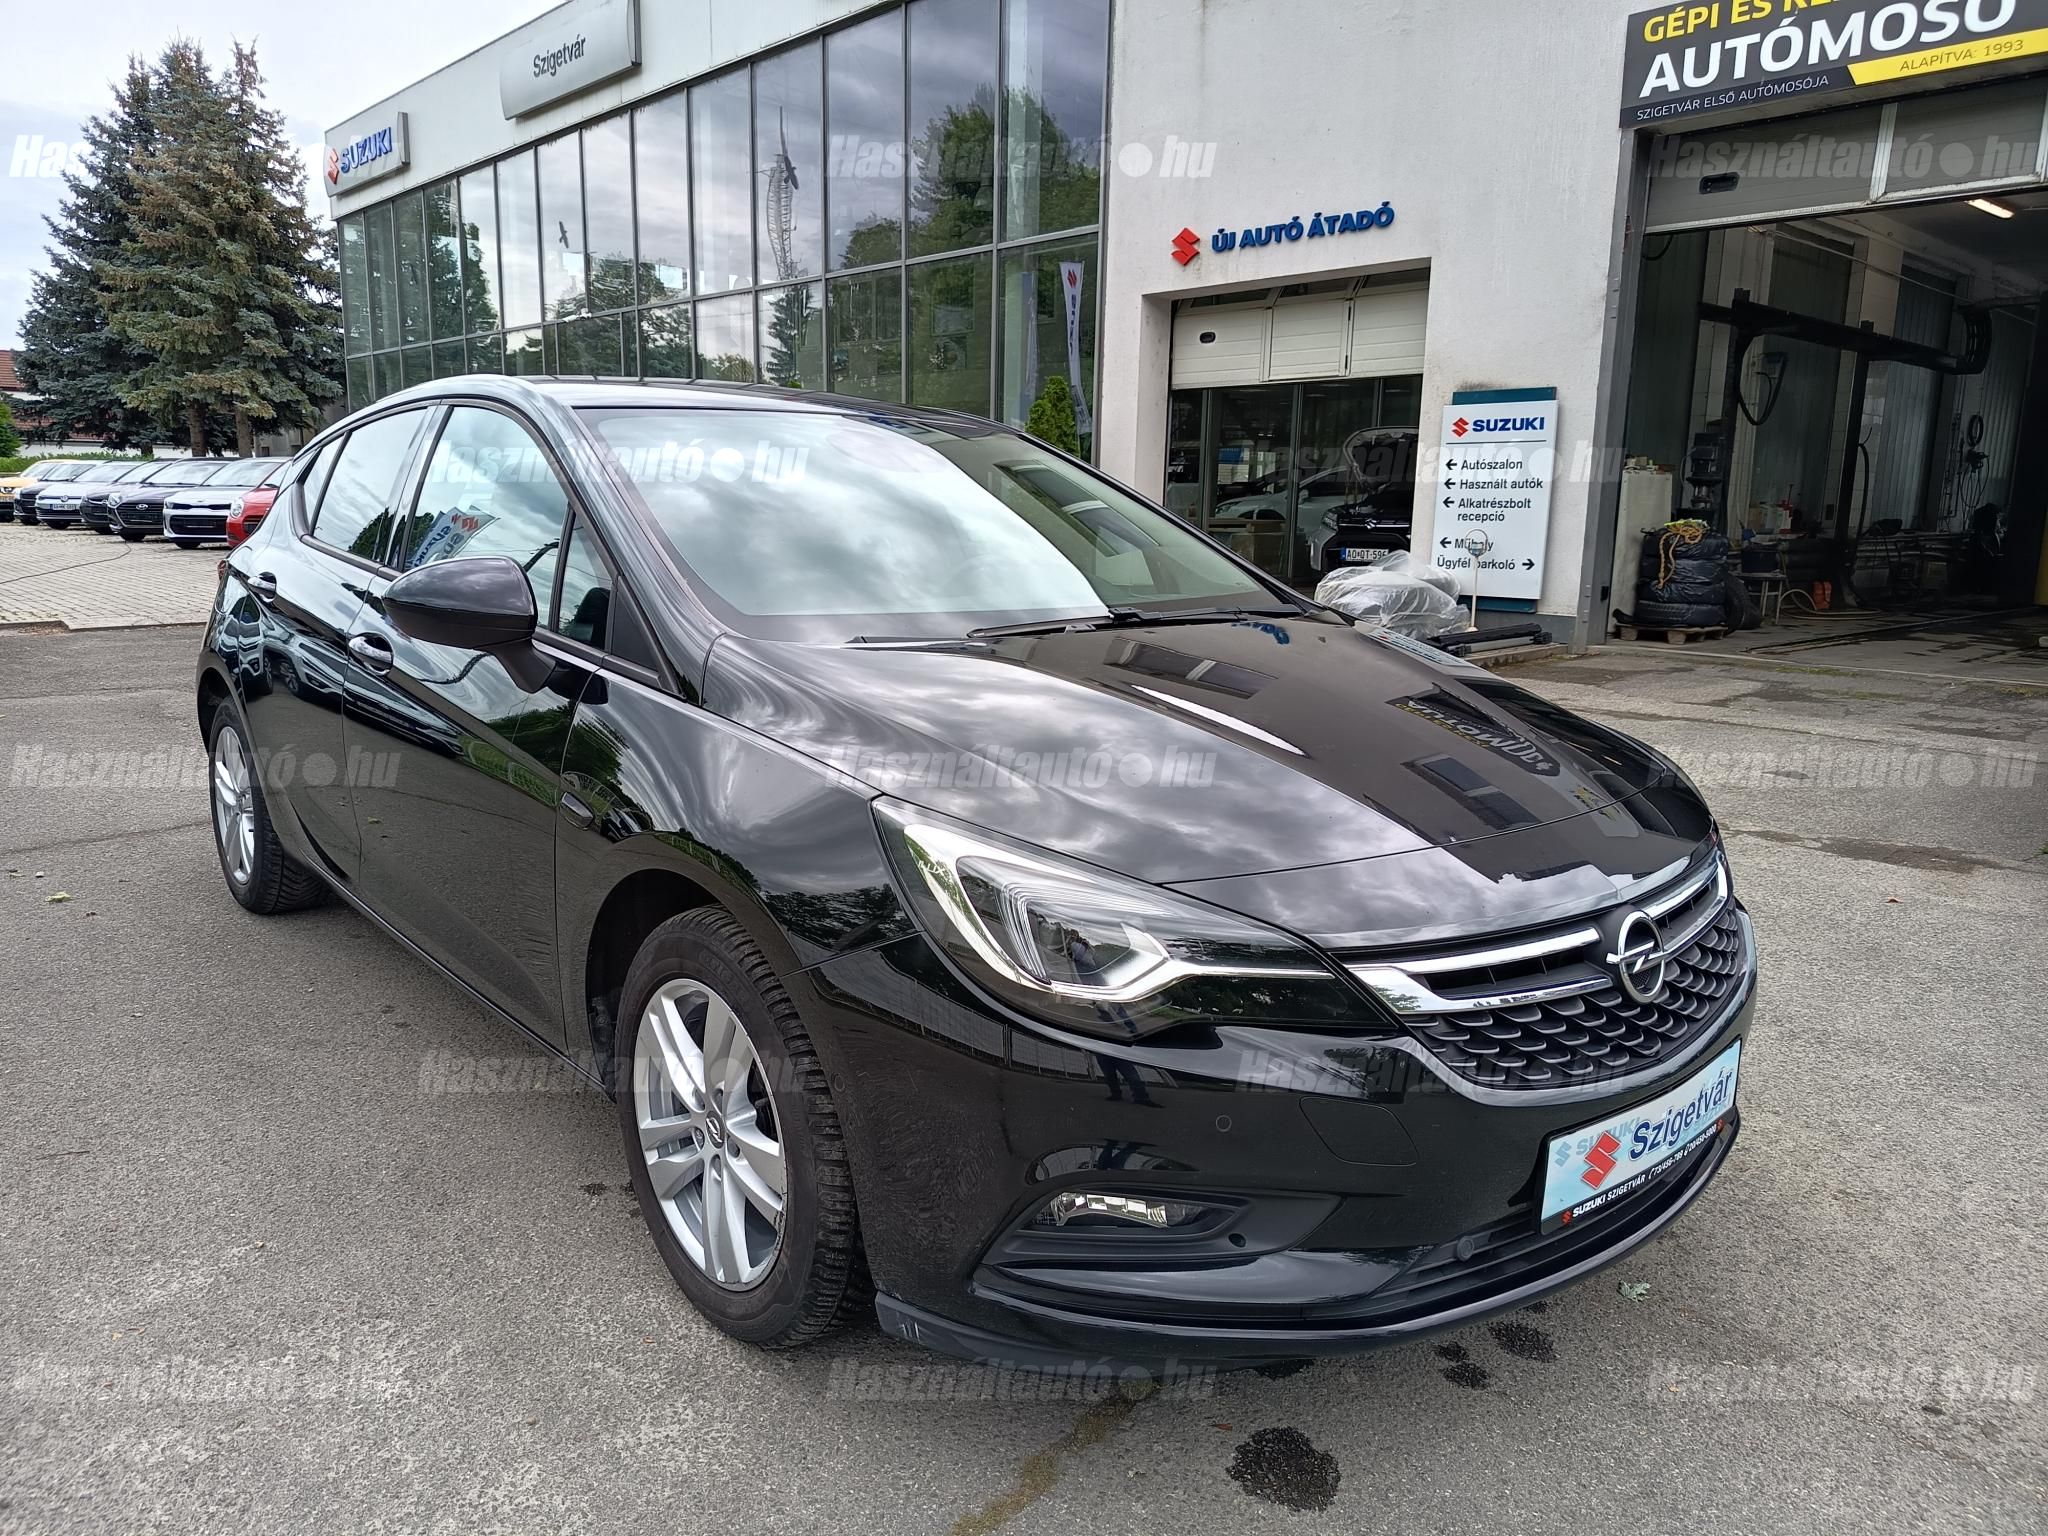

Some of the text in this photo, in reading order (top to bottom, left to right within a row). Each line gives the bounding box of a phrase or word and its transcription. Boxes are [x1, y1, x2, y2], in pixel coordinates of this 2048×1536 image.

[1644, 3, 1719, 42] GÉPI
[533, 34, 586, 77] Szigetvár
[1900, 39, 2024, 72] ALAPÍTVA: 1993
[1637, 75, 1829, 121] SZIGETVÁR ELSŐ AUTÓMOSÓJA
[341, 127, 393, 174] SUZUKI
[1212, 201, 1395, 252] ÚJ AUTÓ ÁTADÓ
[1472, 416, 1545, 432] SUZUKI
[1460, 478, 1543, 490] Használt autók
[1461, 459, 1523, 471] Autószalon
[1457, 510, 1505, 523] recepció
[1458, 498, 1531, 509] Alkatrészbolt
[1630, 1068, 1733, 1160] Szigetvár
[1572, 1194, 1607, 1218] SUZUKI
[1607, 1173, 1646, 1200] SZIGETVÁR
